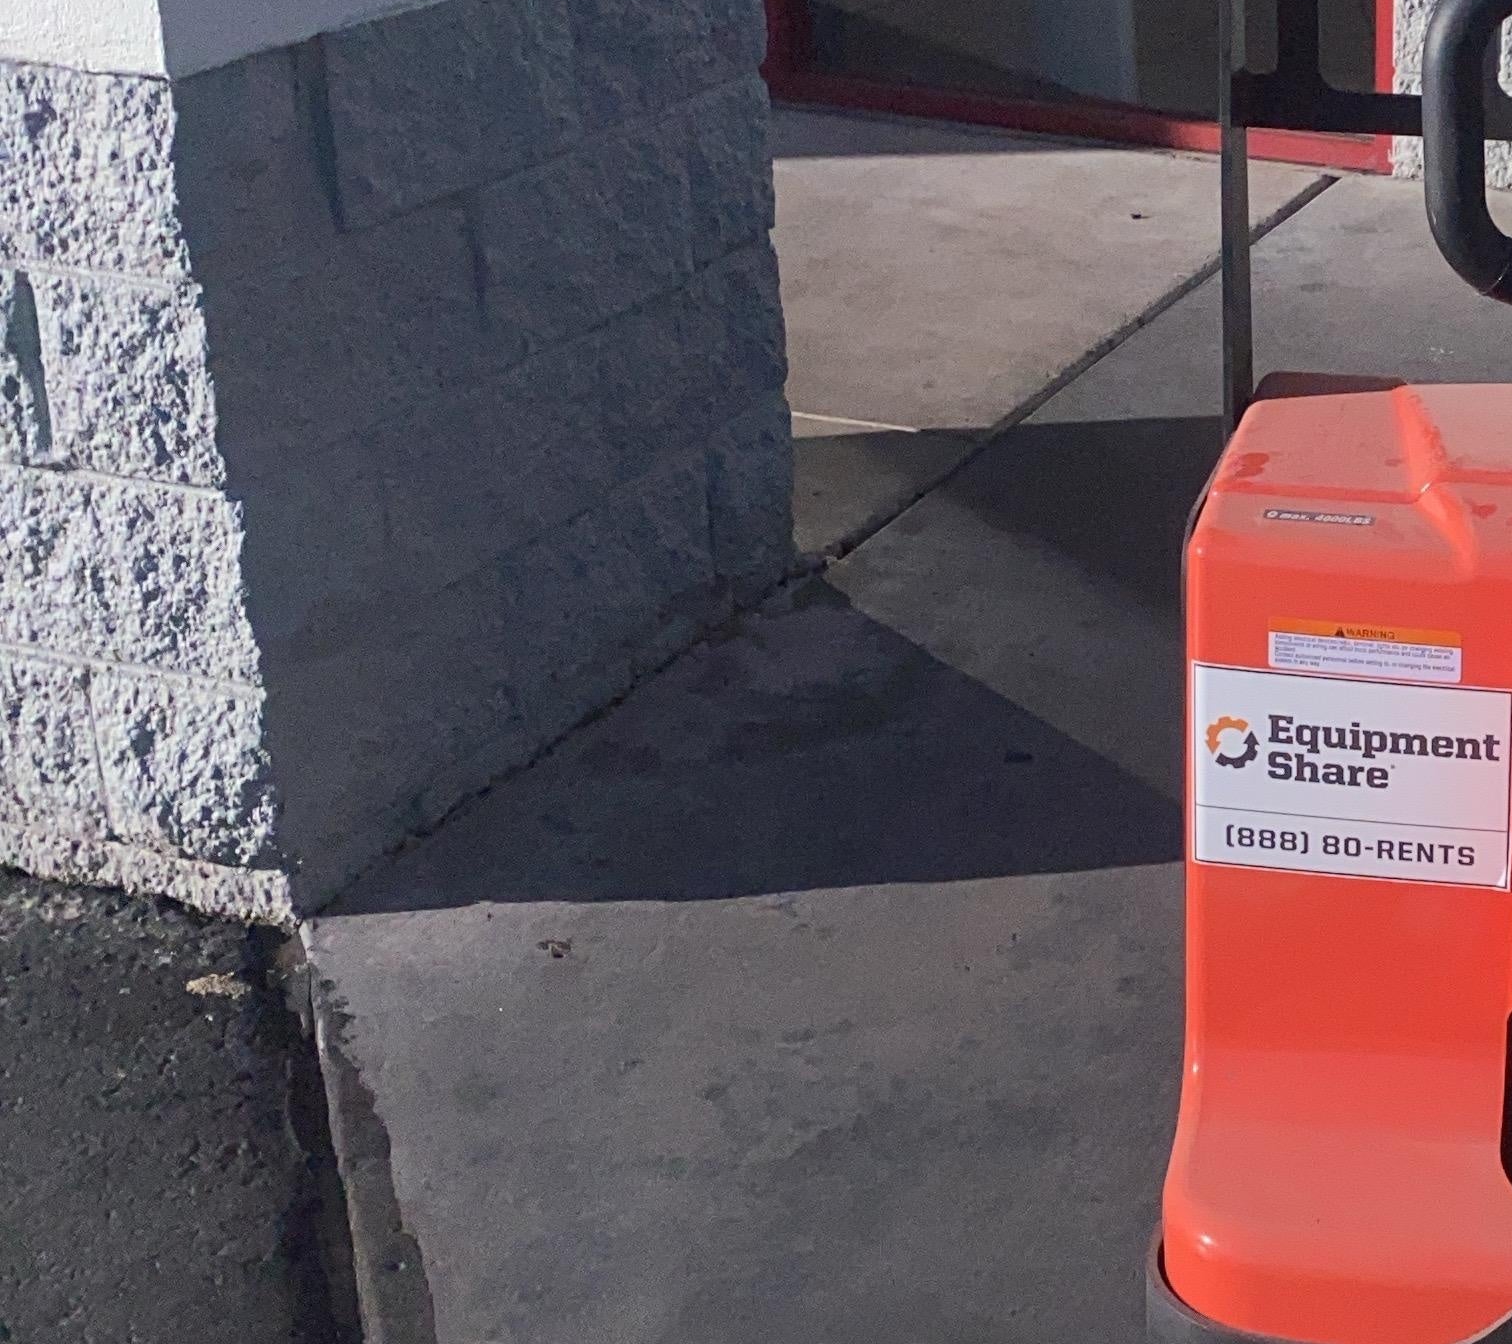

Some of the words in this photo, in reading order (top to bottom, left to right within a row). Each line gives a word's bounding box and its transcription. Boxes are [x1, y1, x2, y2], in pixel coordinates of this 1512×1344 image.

[1345, 628, 1396, 640] WARNING
[1267, 714, 1501, 762] Equipment
[1267, 750, 1389, 789] Share
[1225, 824, 1310, 855] (888)
[1321, 834, 1476, 867] 80-RENTS
